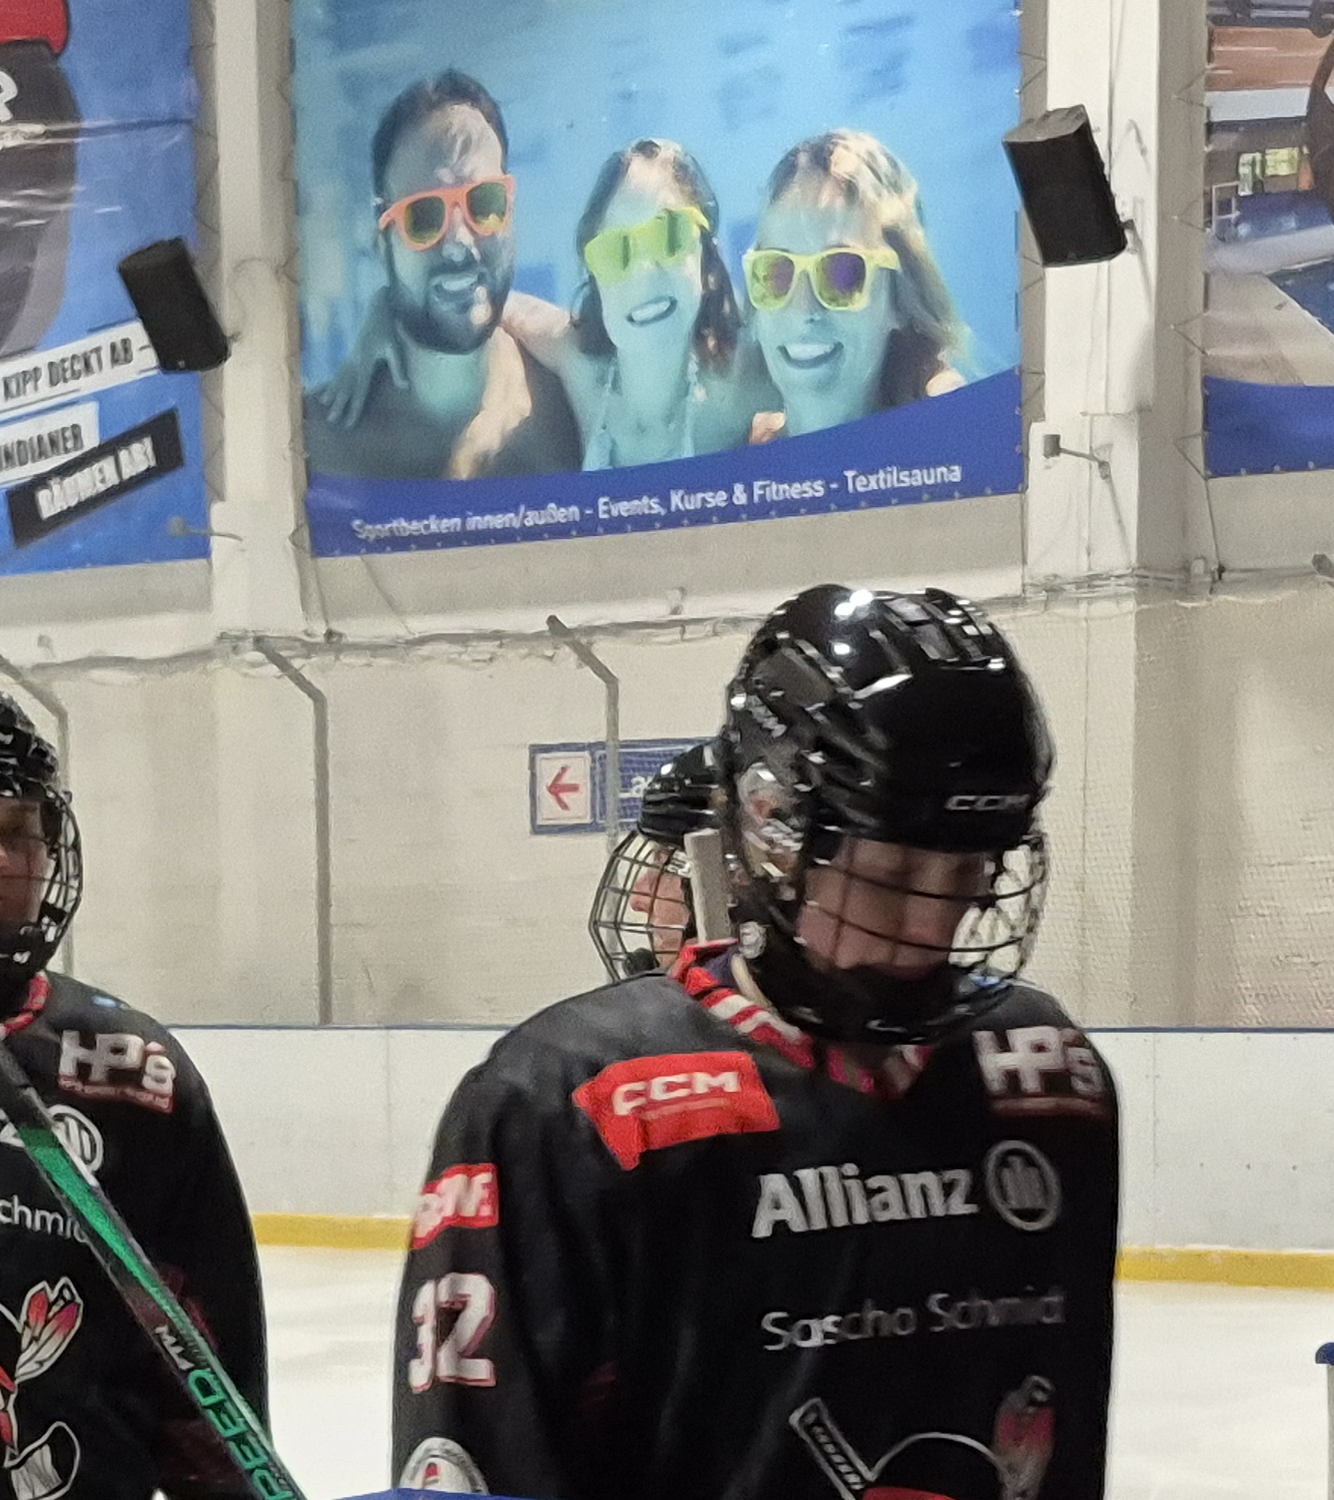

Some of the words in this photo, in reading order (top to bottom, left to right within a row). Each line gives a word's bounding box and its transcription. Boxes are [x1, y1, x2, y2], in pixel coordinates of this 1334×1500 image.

[2, 366, 43, 402] KIPP
[47, 345, 103, 388] DECKT
[109, 337, 134, 369] AB
[352, 515, 462, 543] Sportbecken
[465, 502, 581, 531] innen/außen
[598, 495, 665, 520] Events,
[670, 488, 728, 512] Kurse
[732, 483, 747, 505] &
[753, 478, 825, 504] Fitness
[843, 463, 963, 494] Textilsauna
[611, 1070, 742, 1116] CCM
[750, 1162, 980, 1239] Allianz
